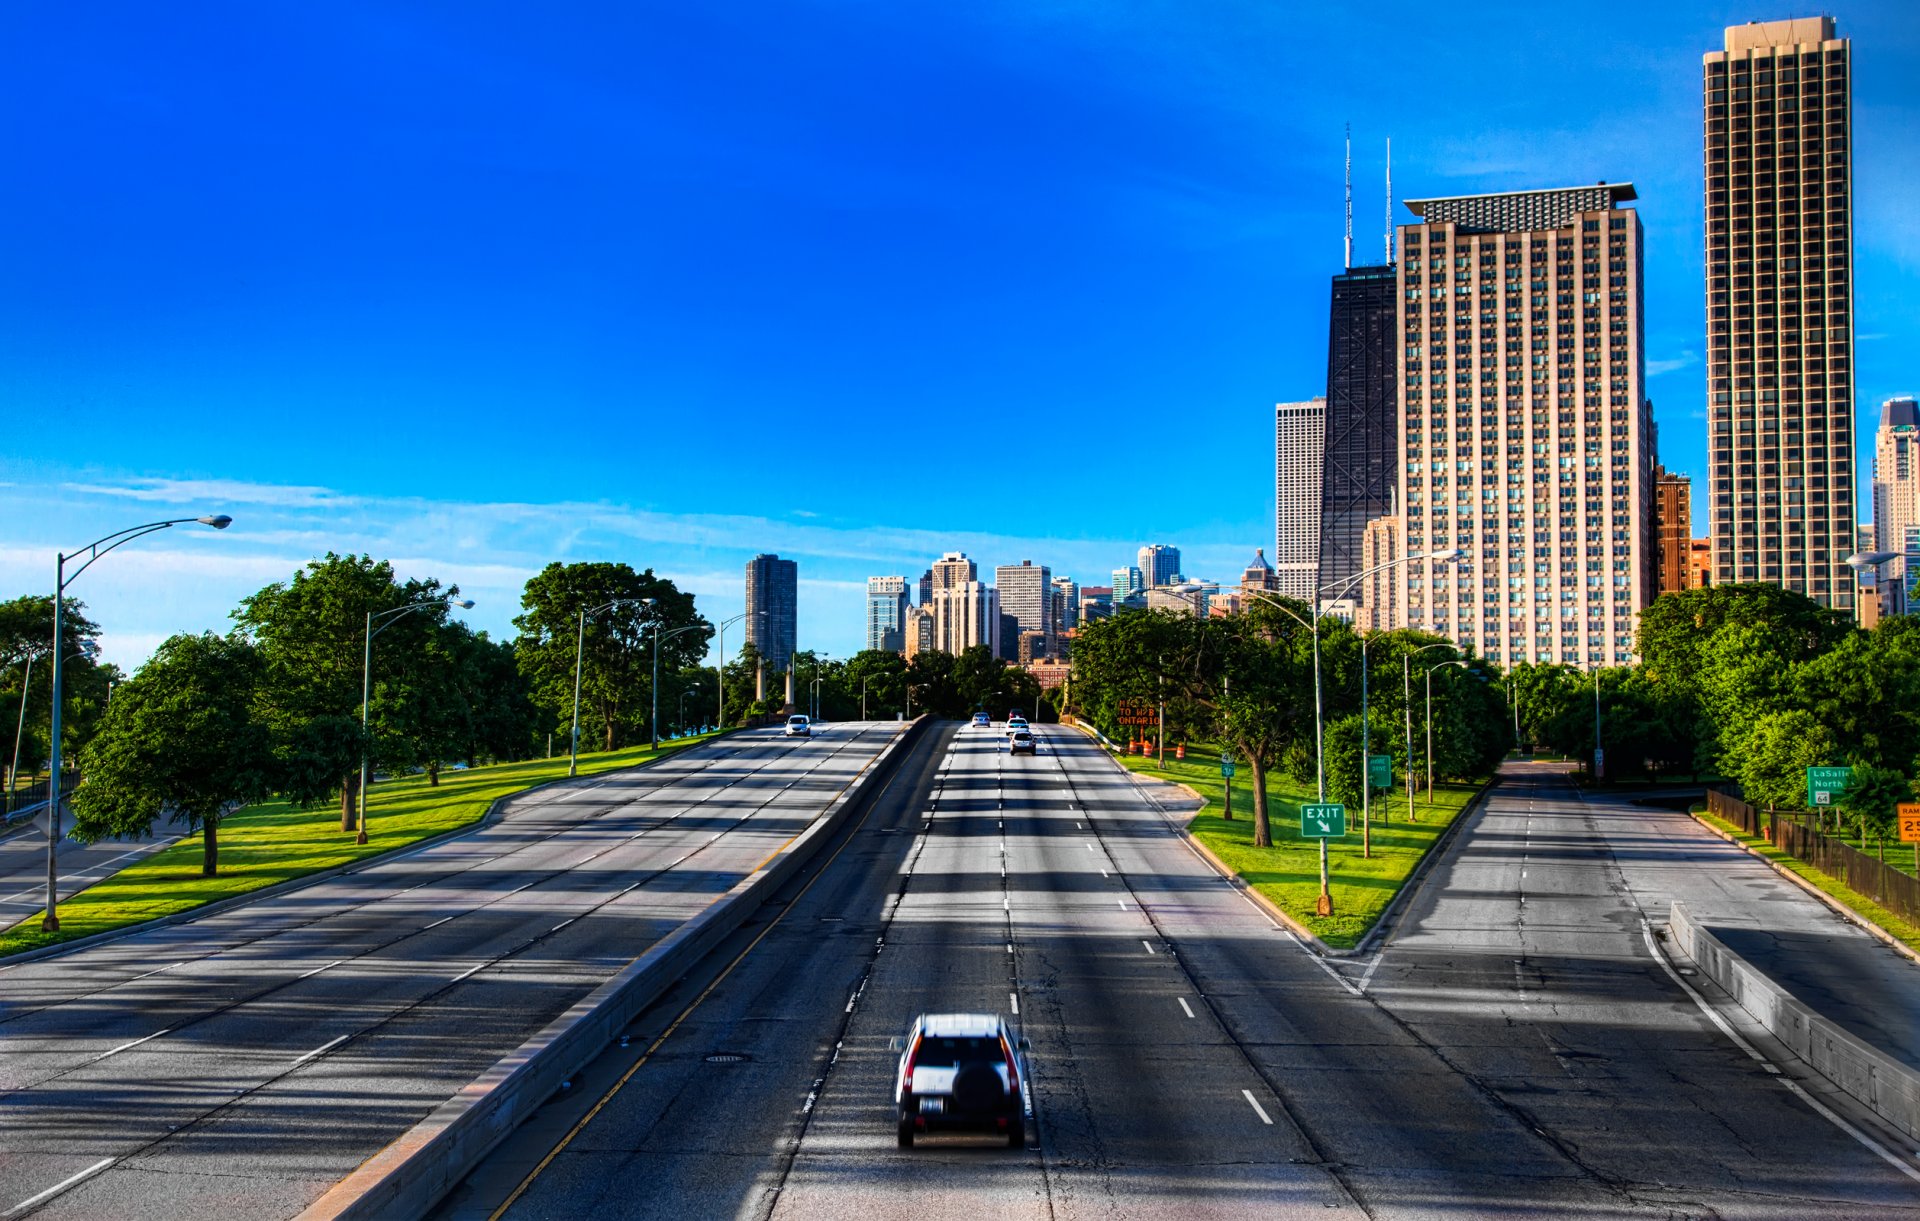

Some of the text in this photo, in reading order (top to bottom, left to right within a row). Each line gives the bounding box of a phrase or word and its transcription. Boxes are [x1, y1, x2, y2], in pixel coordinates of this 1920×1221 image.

[1120, 707, 1154, 716] TO W/B
[1119, 716, 1160, 725] ONTARIO
[1815, 780, 1843, 788] North
[1307, 808, 1339, 818] EXIT
